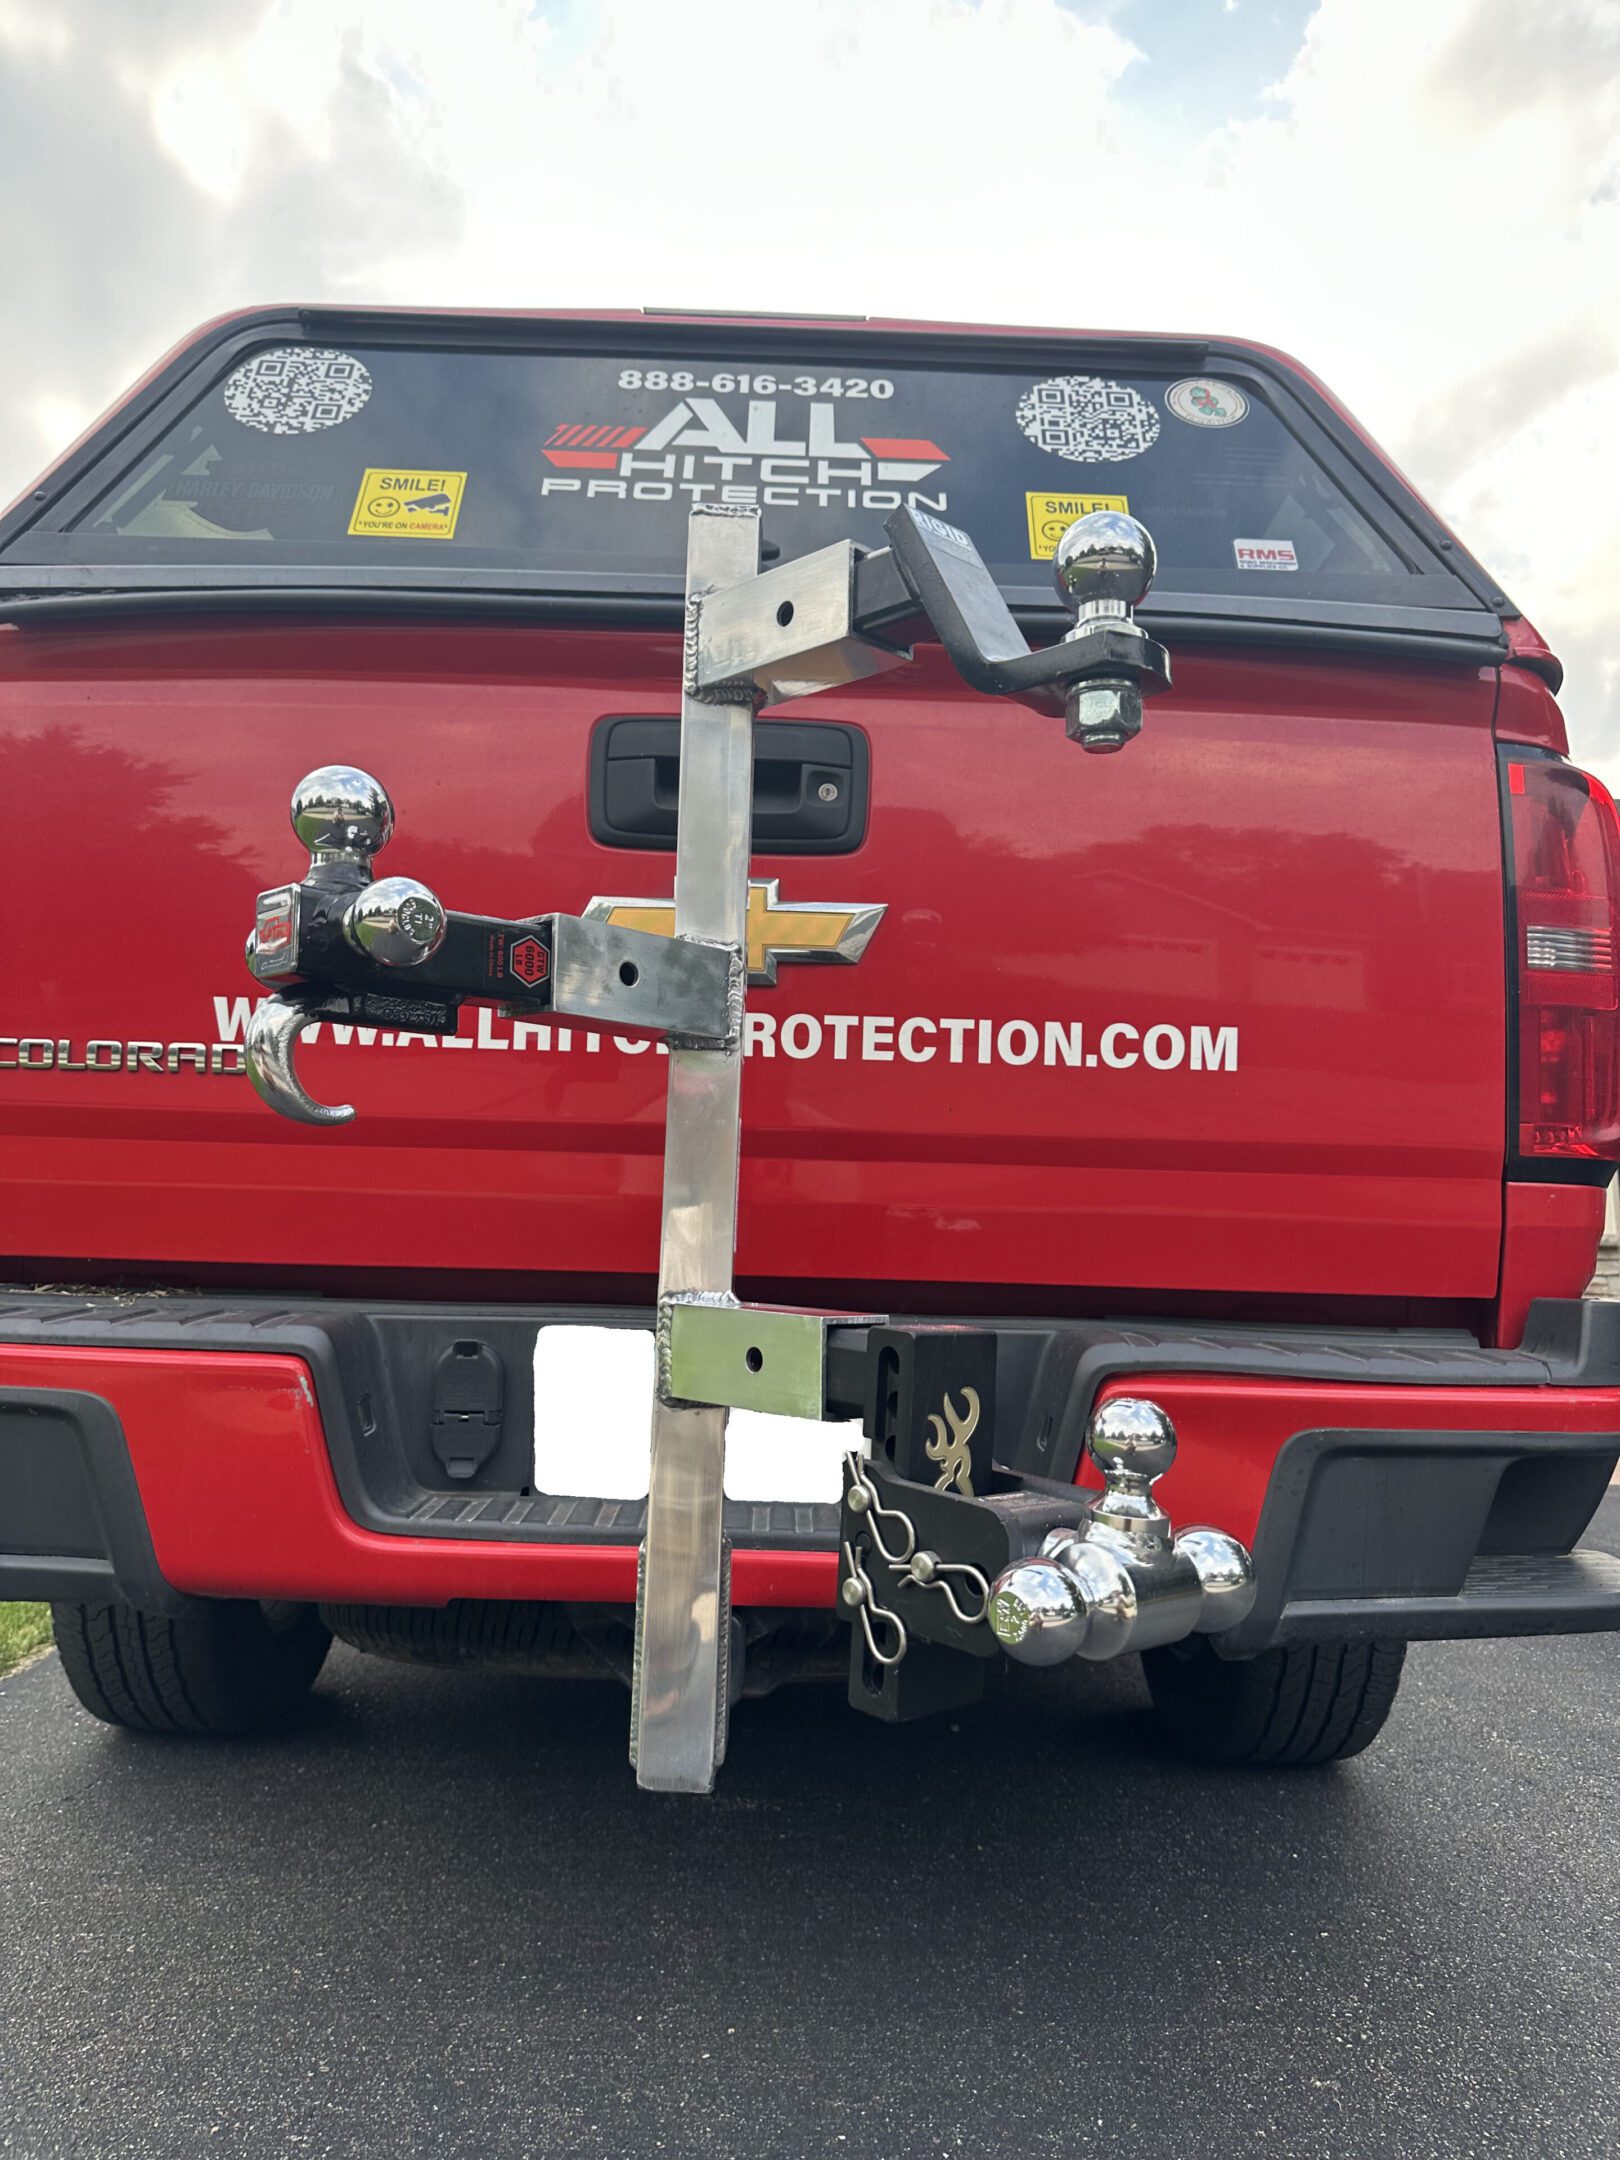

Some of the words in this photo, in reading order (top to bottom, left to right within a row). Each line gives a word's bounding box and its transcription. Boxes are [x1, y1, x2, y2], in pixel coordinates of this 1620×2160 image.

[617, 369, 895, 400] 888-616-3420
[633, 397, 872, 460] ALL
[379, 477, 446, 492] SMILE!
[617, 452, 872, 486] HITCH
[541, 477, 947, 512] PROTECTION
[1237, 548, 1295, 561] RMS
[525, 945, 535, 976] 6000
[0, 1037, 248, 1074] OLORAD
